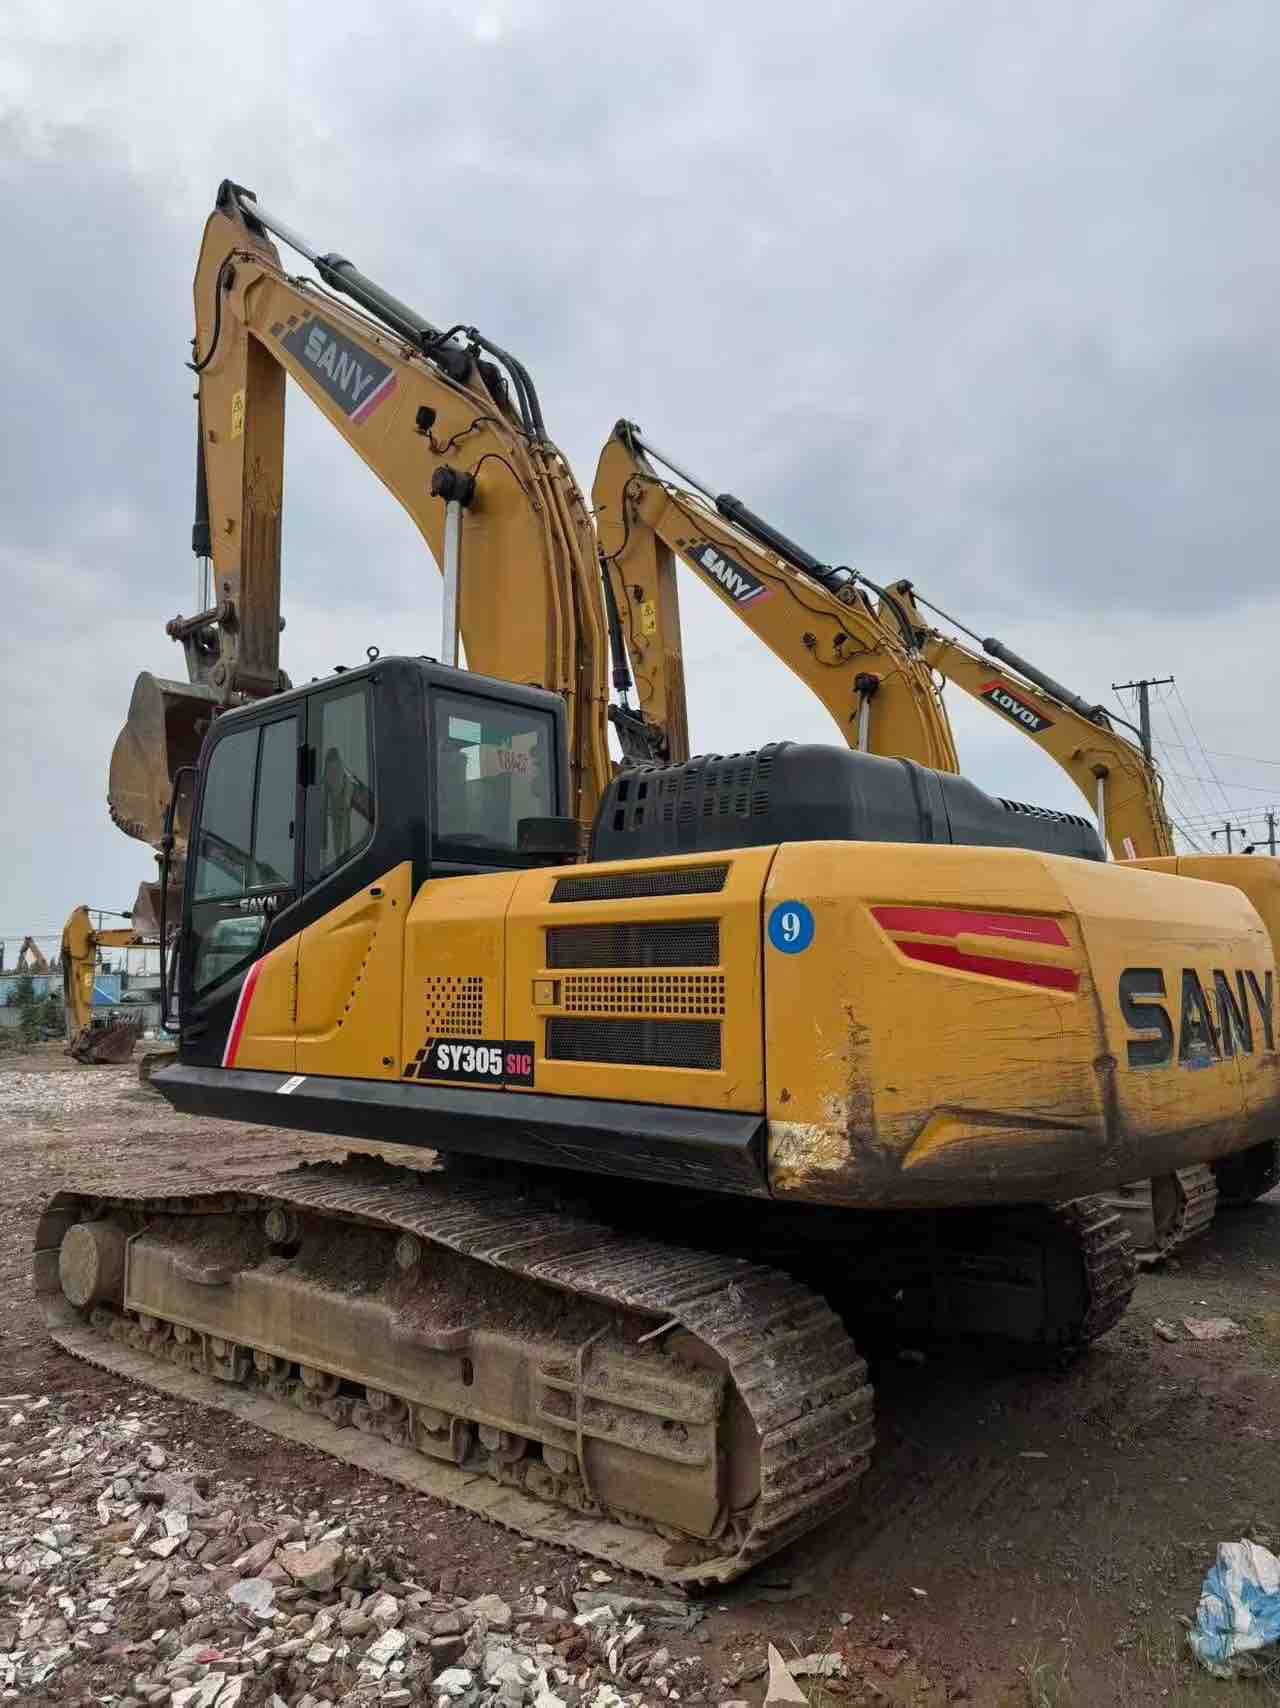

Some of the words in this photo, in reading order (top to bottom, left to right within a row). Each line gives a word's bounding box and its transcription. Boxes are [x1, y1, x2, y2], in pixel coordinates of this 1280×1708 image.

[303, 326, 374, 401] SANY
[700, 547, 752, 597] SANY
[781, 911, 801, 942] 9
[1118, 967, 1275, 1069] SANY
[436, 1043, 503, 1076] SY305
